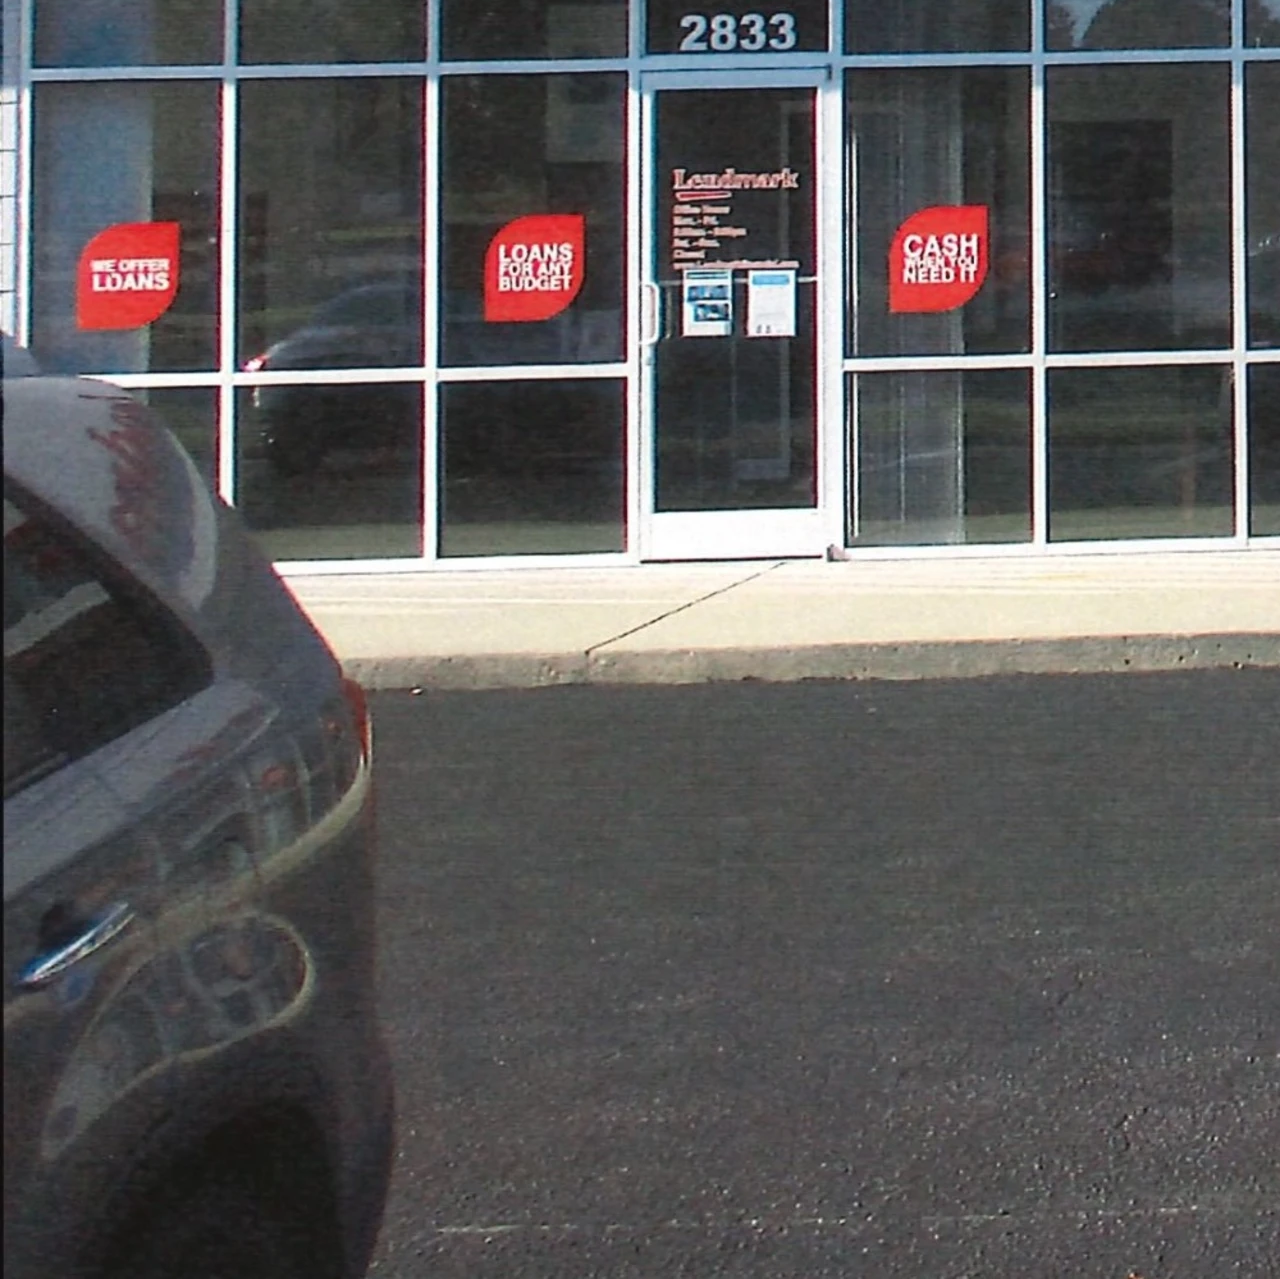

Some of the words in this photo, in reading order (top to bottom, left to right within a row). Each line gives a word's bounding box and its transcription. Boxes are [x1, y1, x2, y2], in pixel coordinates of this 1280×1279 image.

[680, 13, 796, 51] 2833
[673, 168, 799, 189] Lendmark
[498, 243, 573, 262] LOANS
[903, 233, 978, 257] CASH
[90, 260, 117, 272] WE
[119, 259, 170, 272] OFFER
[499, 262, 533, 277] FOR
[537, 261, 573, 277] ANY
[92, 272, 170, 292] LOANS
[498, 276, 573, 292] BUDGET
[903, 268, 956, 283] NEED
[960, 268, 977, 283] IT
